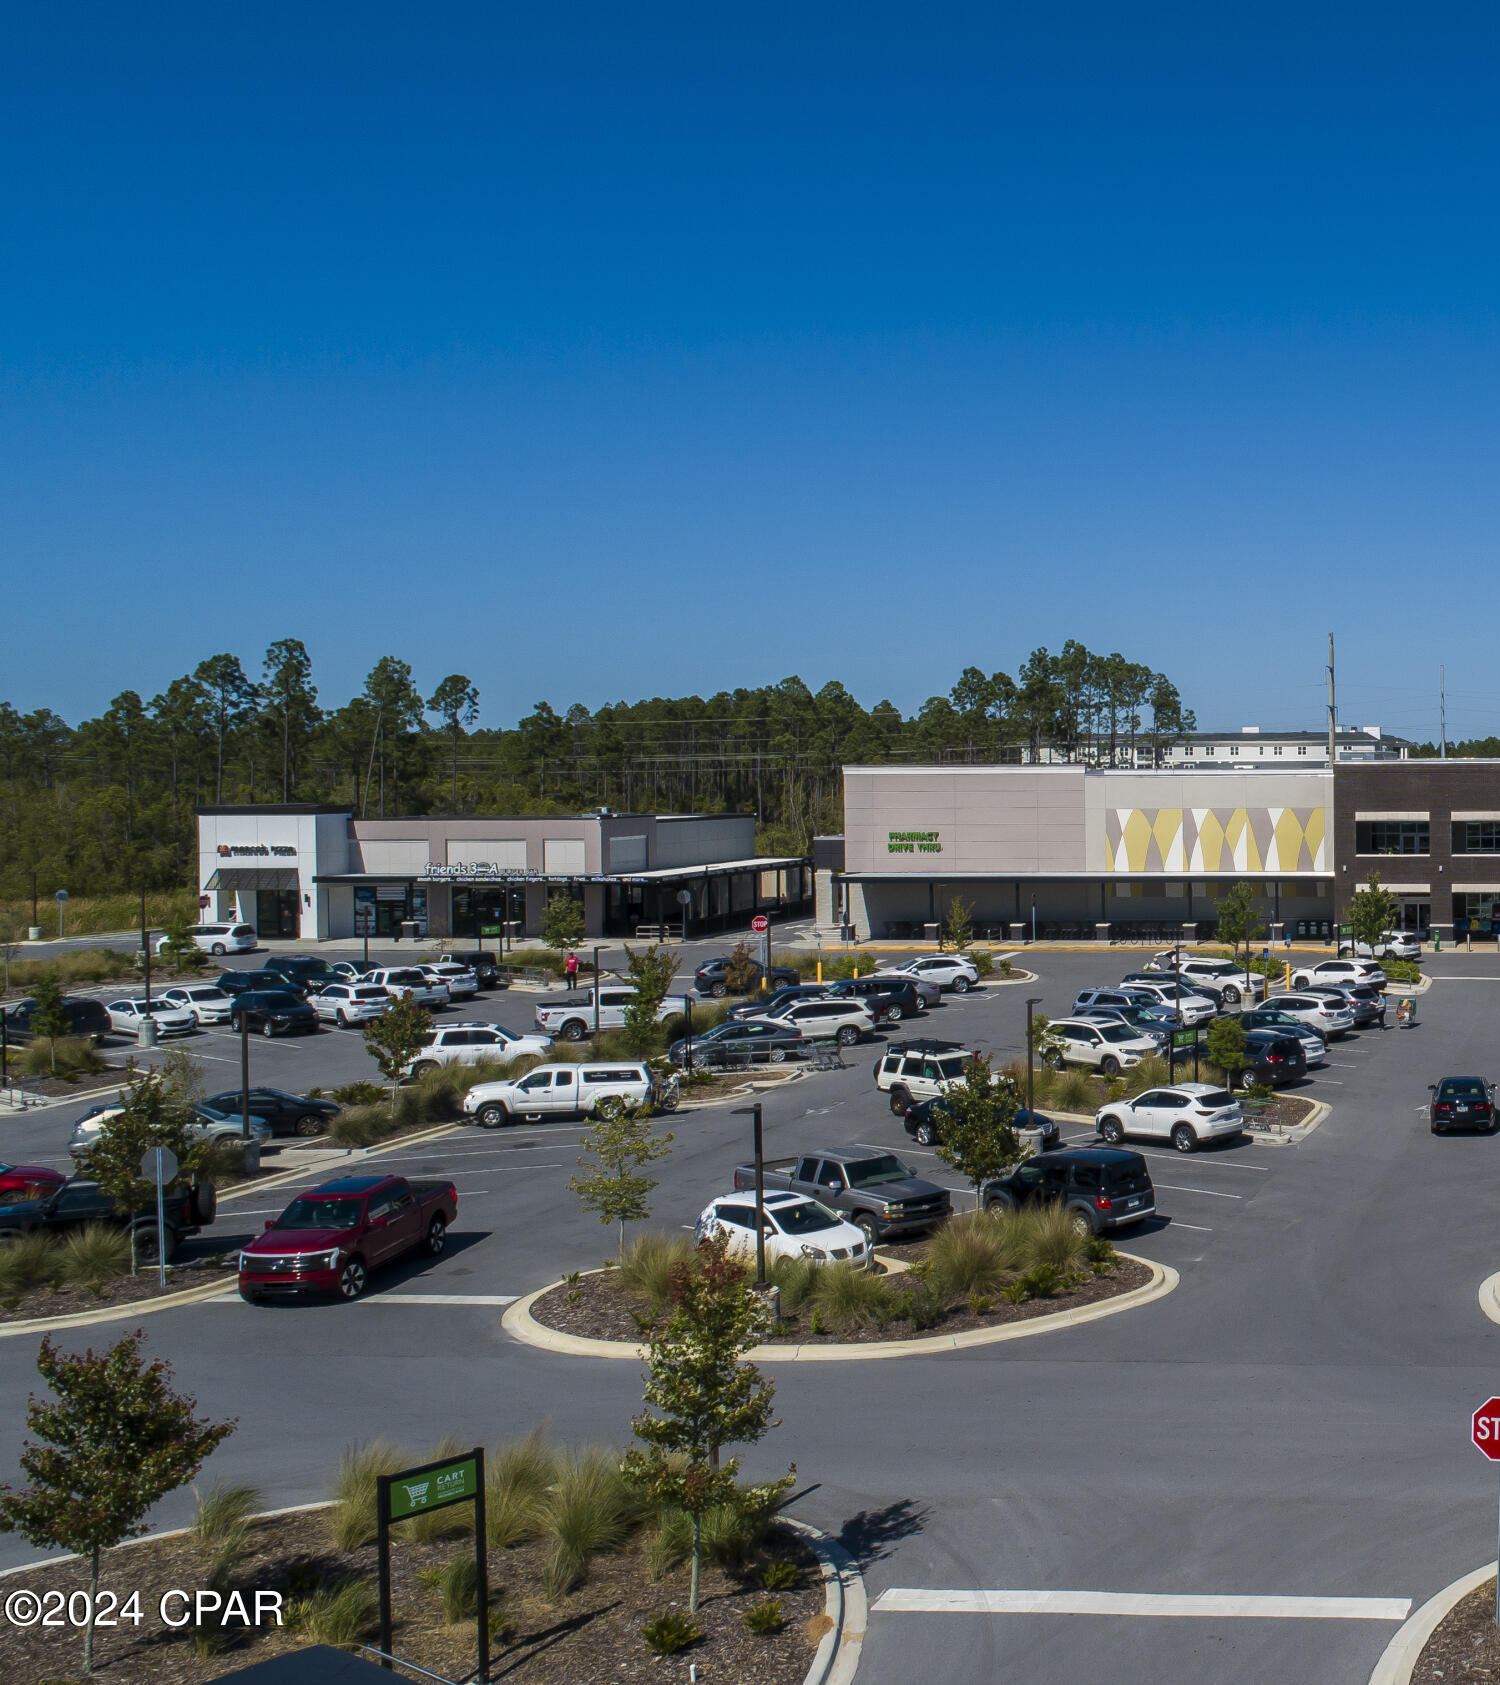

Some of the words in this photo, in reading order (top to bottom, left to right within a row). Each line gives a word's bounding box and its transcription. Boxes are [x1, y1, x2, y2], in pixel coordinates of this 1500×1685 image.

[888, 831, 939, 842] PHARMACY
[887, 842, 914, 853] DRIVE
[424, 861, 467, 875] friends
[753, 920, 768, 928] STOP
[436, 1469, 465, 1485] CART
